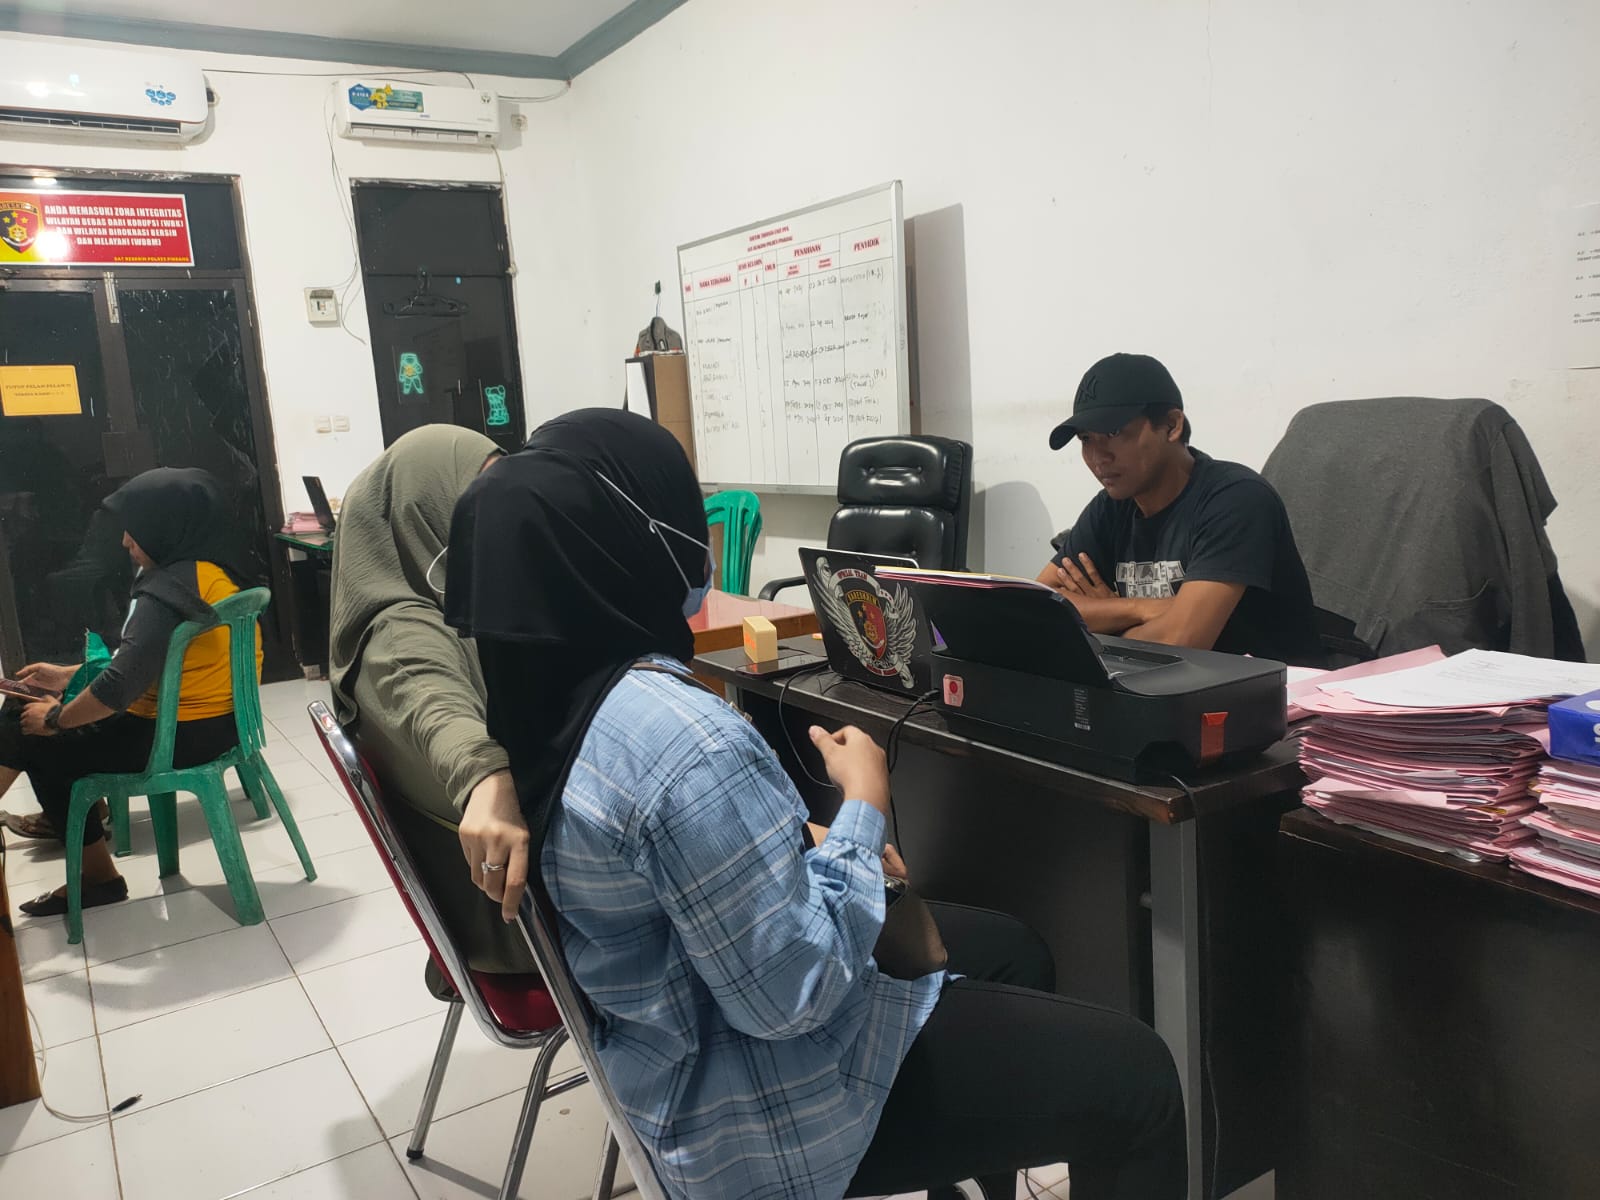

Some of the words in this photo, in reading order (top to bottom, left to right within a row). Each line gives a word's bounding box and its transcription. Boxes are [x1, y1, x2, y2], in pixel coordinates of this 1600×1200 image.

[44, 205, 68, 215] ANDA
[68, 206, 114, 216] MEMASUKI
[114, 207, 136, 217] ZONA
[136, 208, 183, 218] INTEGRITAS
[45, 217, 81, 226] WILAYAH
